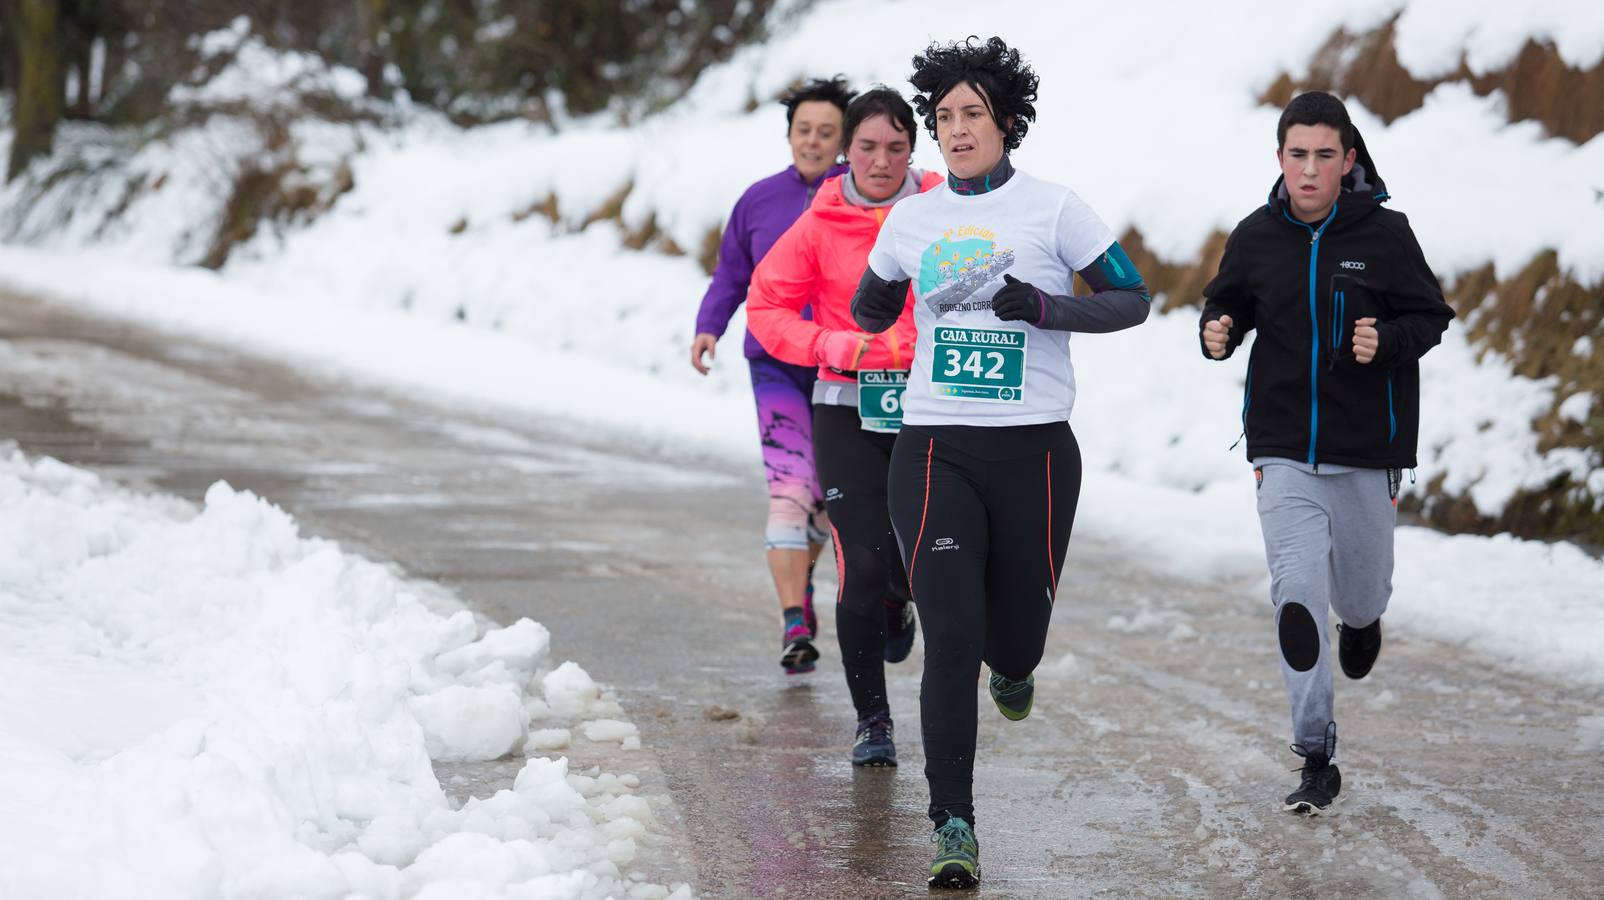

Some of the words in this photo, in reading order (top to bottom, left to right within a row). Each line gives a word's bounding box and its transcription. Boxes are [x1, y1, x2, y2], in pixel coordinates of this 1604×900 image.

[1340, 261, 1366, 270] +8000
[972, 300, 993, 311] CORR
[940, 330, 969, 342] CAJA
[971, 332, 1019, 345] RURAL
[944, 349, 1005, 380] 342
